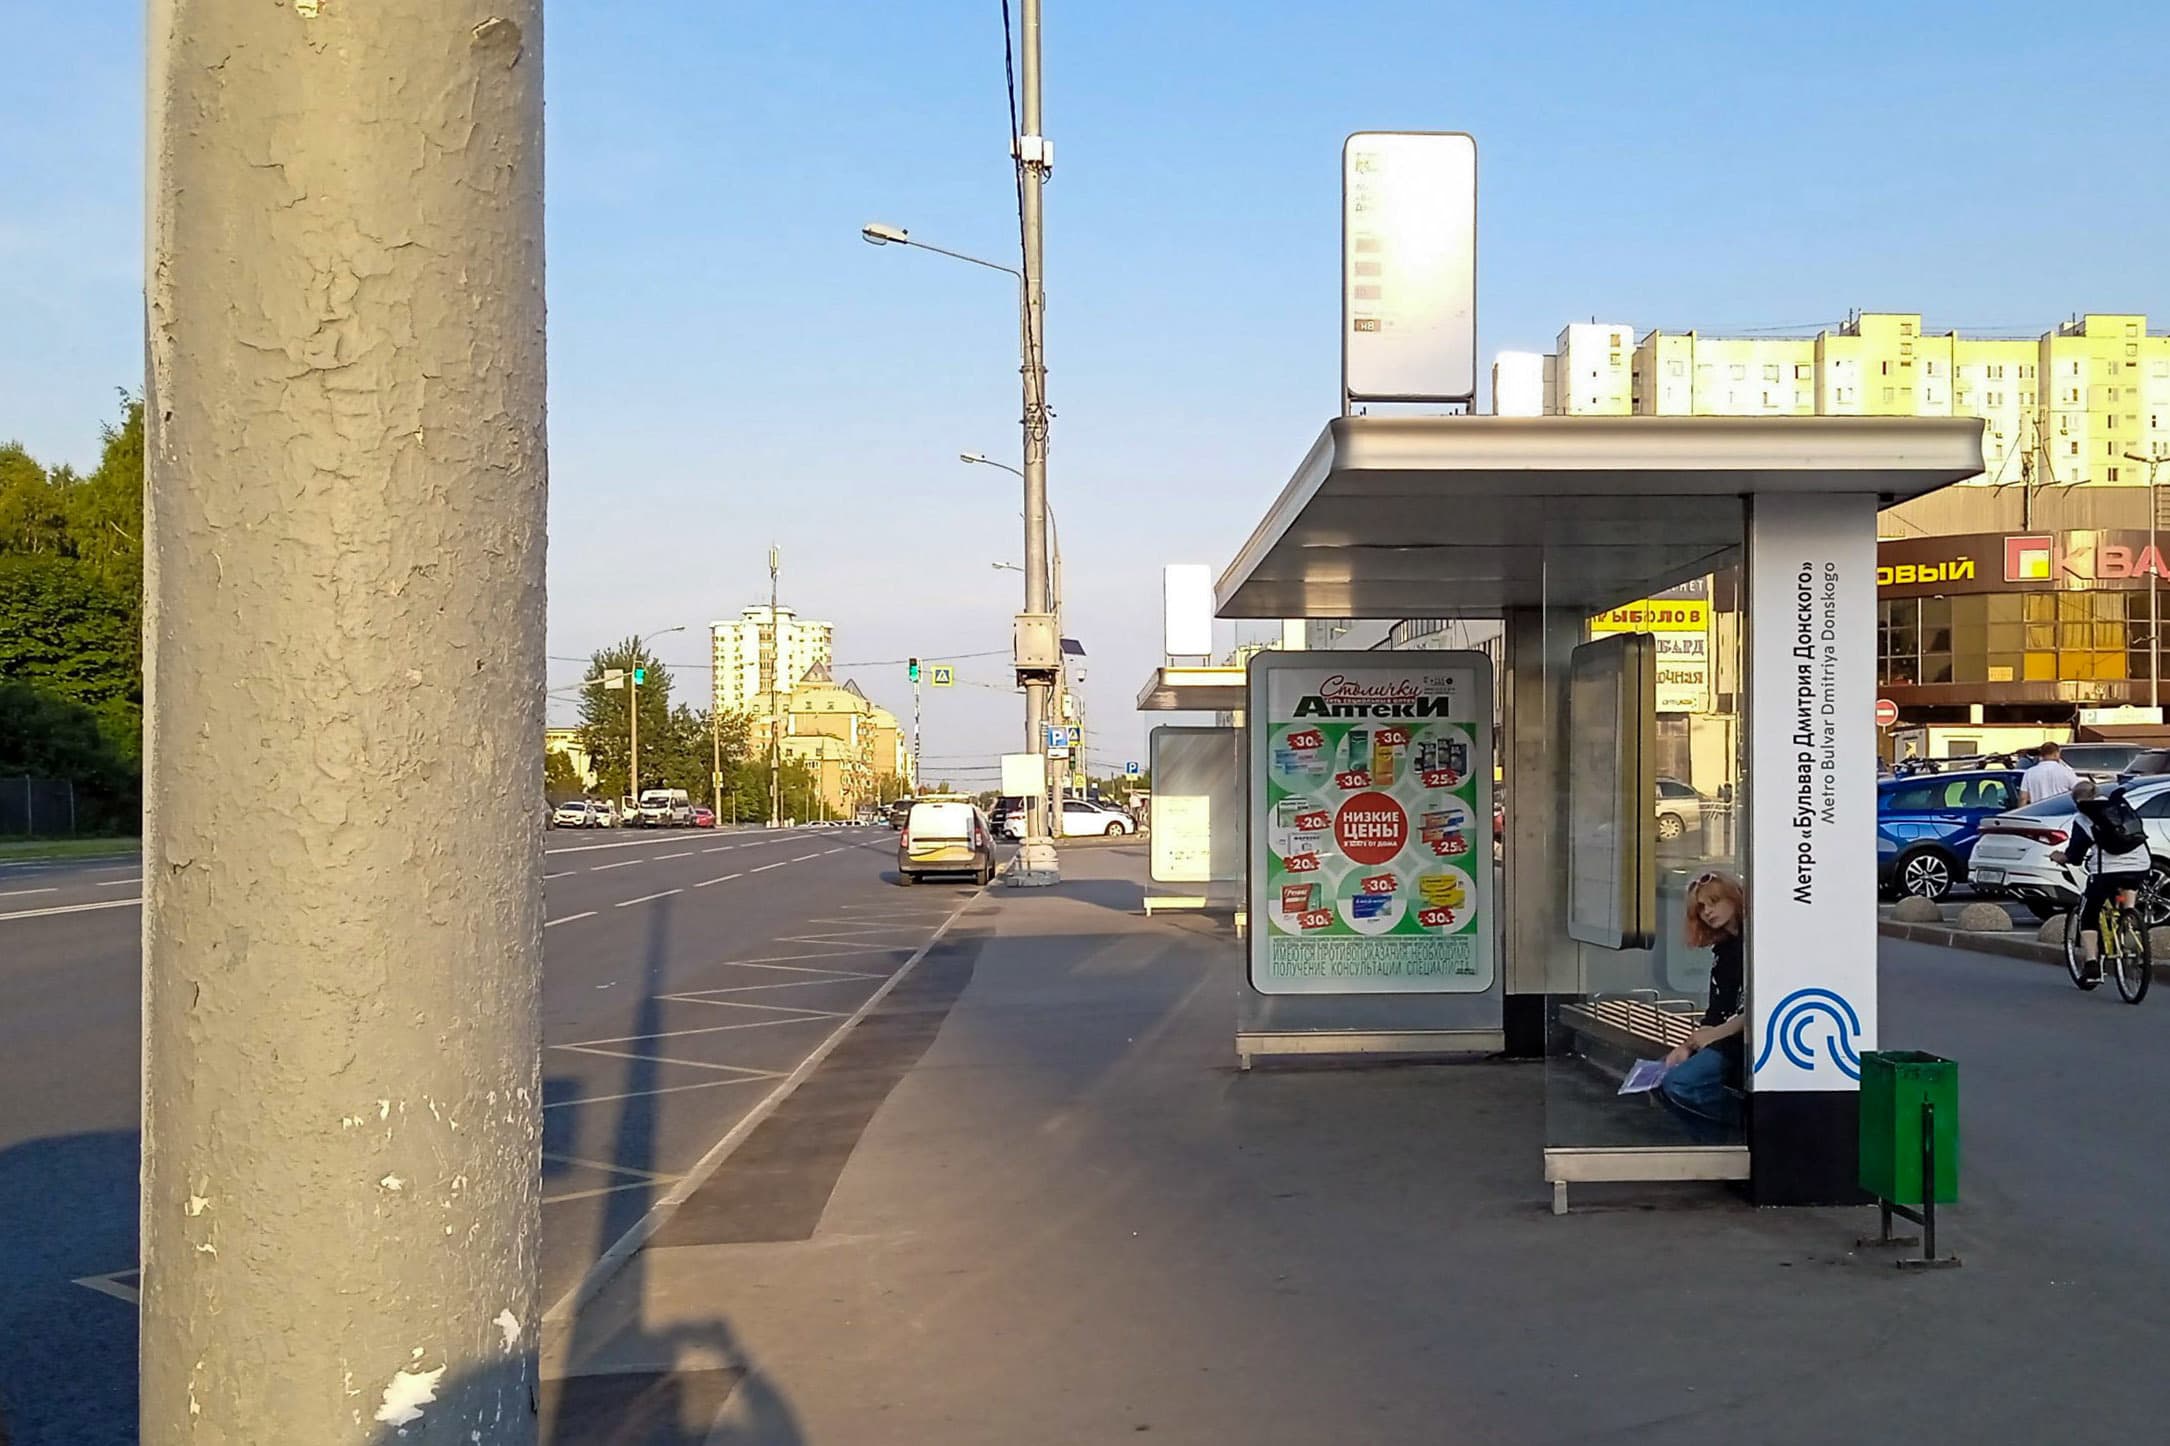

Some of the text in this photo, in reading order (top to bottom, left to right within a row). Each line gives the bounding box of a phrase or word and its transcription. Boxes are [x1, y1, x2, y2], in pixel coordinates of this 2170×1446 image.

[2053, 545, 2170, 580] КВА
[1820, 562, 1838, 824] Metro Bulvar Dmitriya Donskogo
[1793, 562, 1816, 904] Метро «Бульвар Дмитрия Донского»
[1343, 811, 1399, 822] НИЗКИЕ
[1343, 823, 1399, 840] ЦЕНЫ
